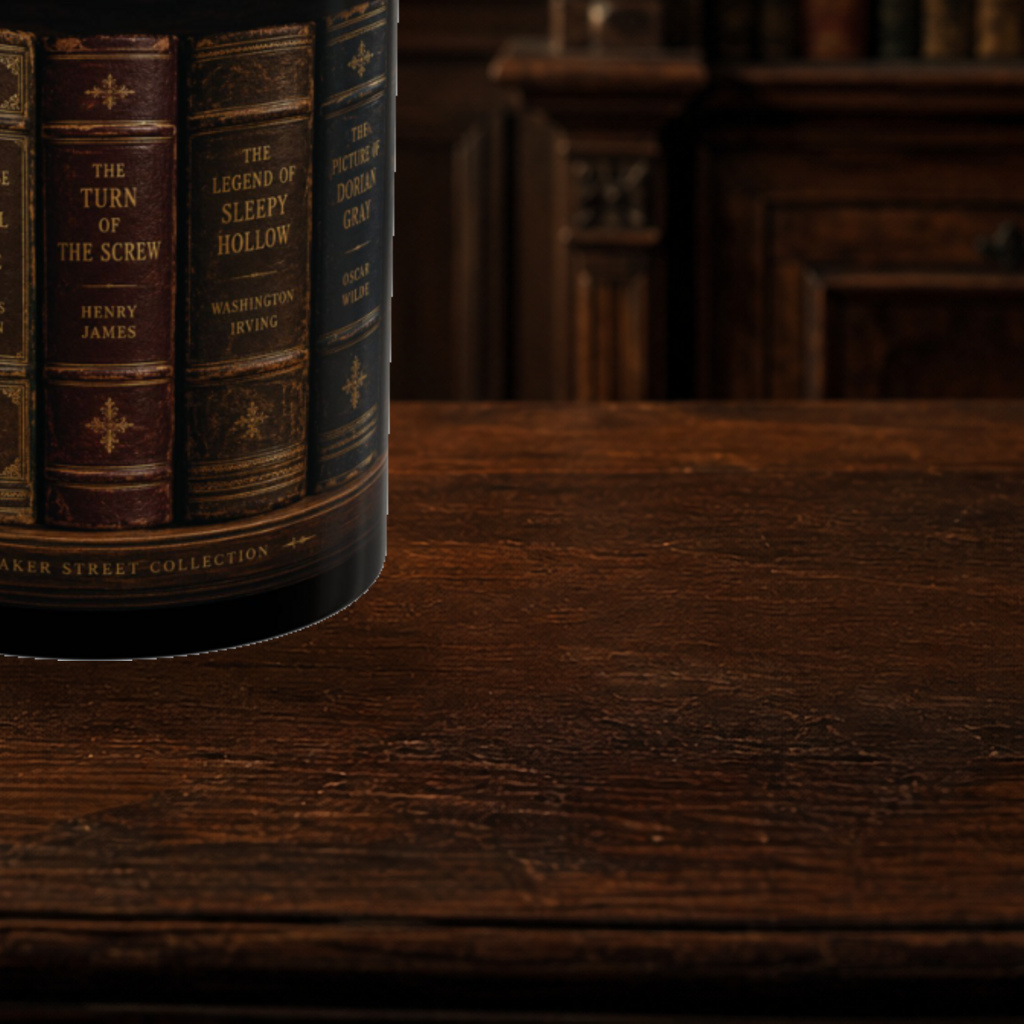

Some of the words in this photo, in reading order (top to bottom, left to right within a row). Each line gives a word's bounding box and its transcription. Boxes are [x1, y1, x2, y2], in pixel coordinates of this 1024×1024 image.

[351, 122, 369, 142] THE
[242, 145, 271, 164] THE
[332, 147, 370, 175] PICTURE
[92, 163, 125, 178] THE
[212, 170, 274, 194] LEGEND
[279, 165, 296, 184] OF
[80, 187, 138, 208] TURN
[337, 168, 376, 203] DORIAN
[221, 193, 289, 224] SLEEPY
[343, 198, 372, 230] GRAY
[98, 217, 121, 233] OF
[57, 242, 93, 262] THE
[100, 241, 162, 262] SCREW
[217, 224, 291, 256] HOLLOW
[342, 262, 370, 286] OSCAR
[211, 288, 295, 315] WASHINGTON
[342, 282, 370, 307] WILDE
[81, 305, 138, 319] HENRY
[81, 325, 136, 339] JAMES
[230, 314, 278, 336] IRVING
[62, 561, 139, 575] STREET
[150, 544, 269, 573] COLLECTION
